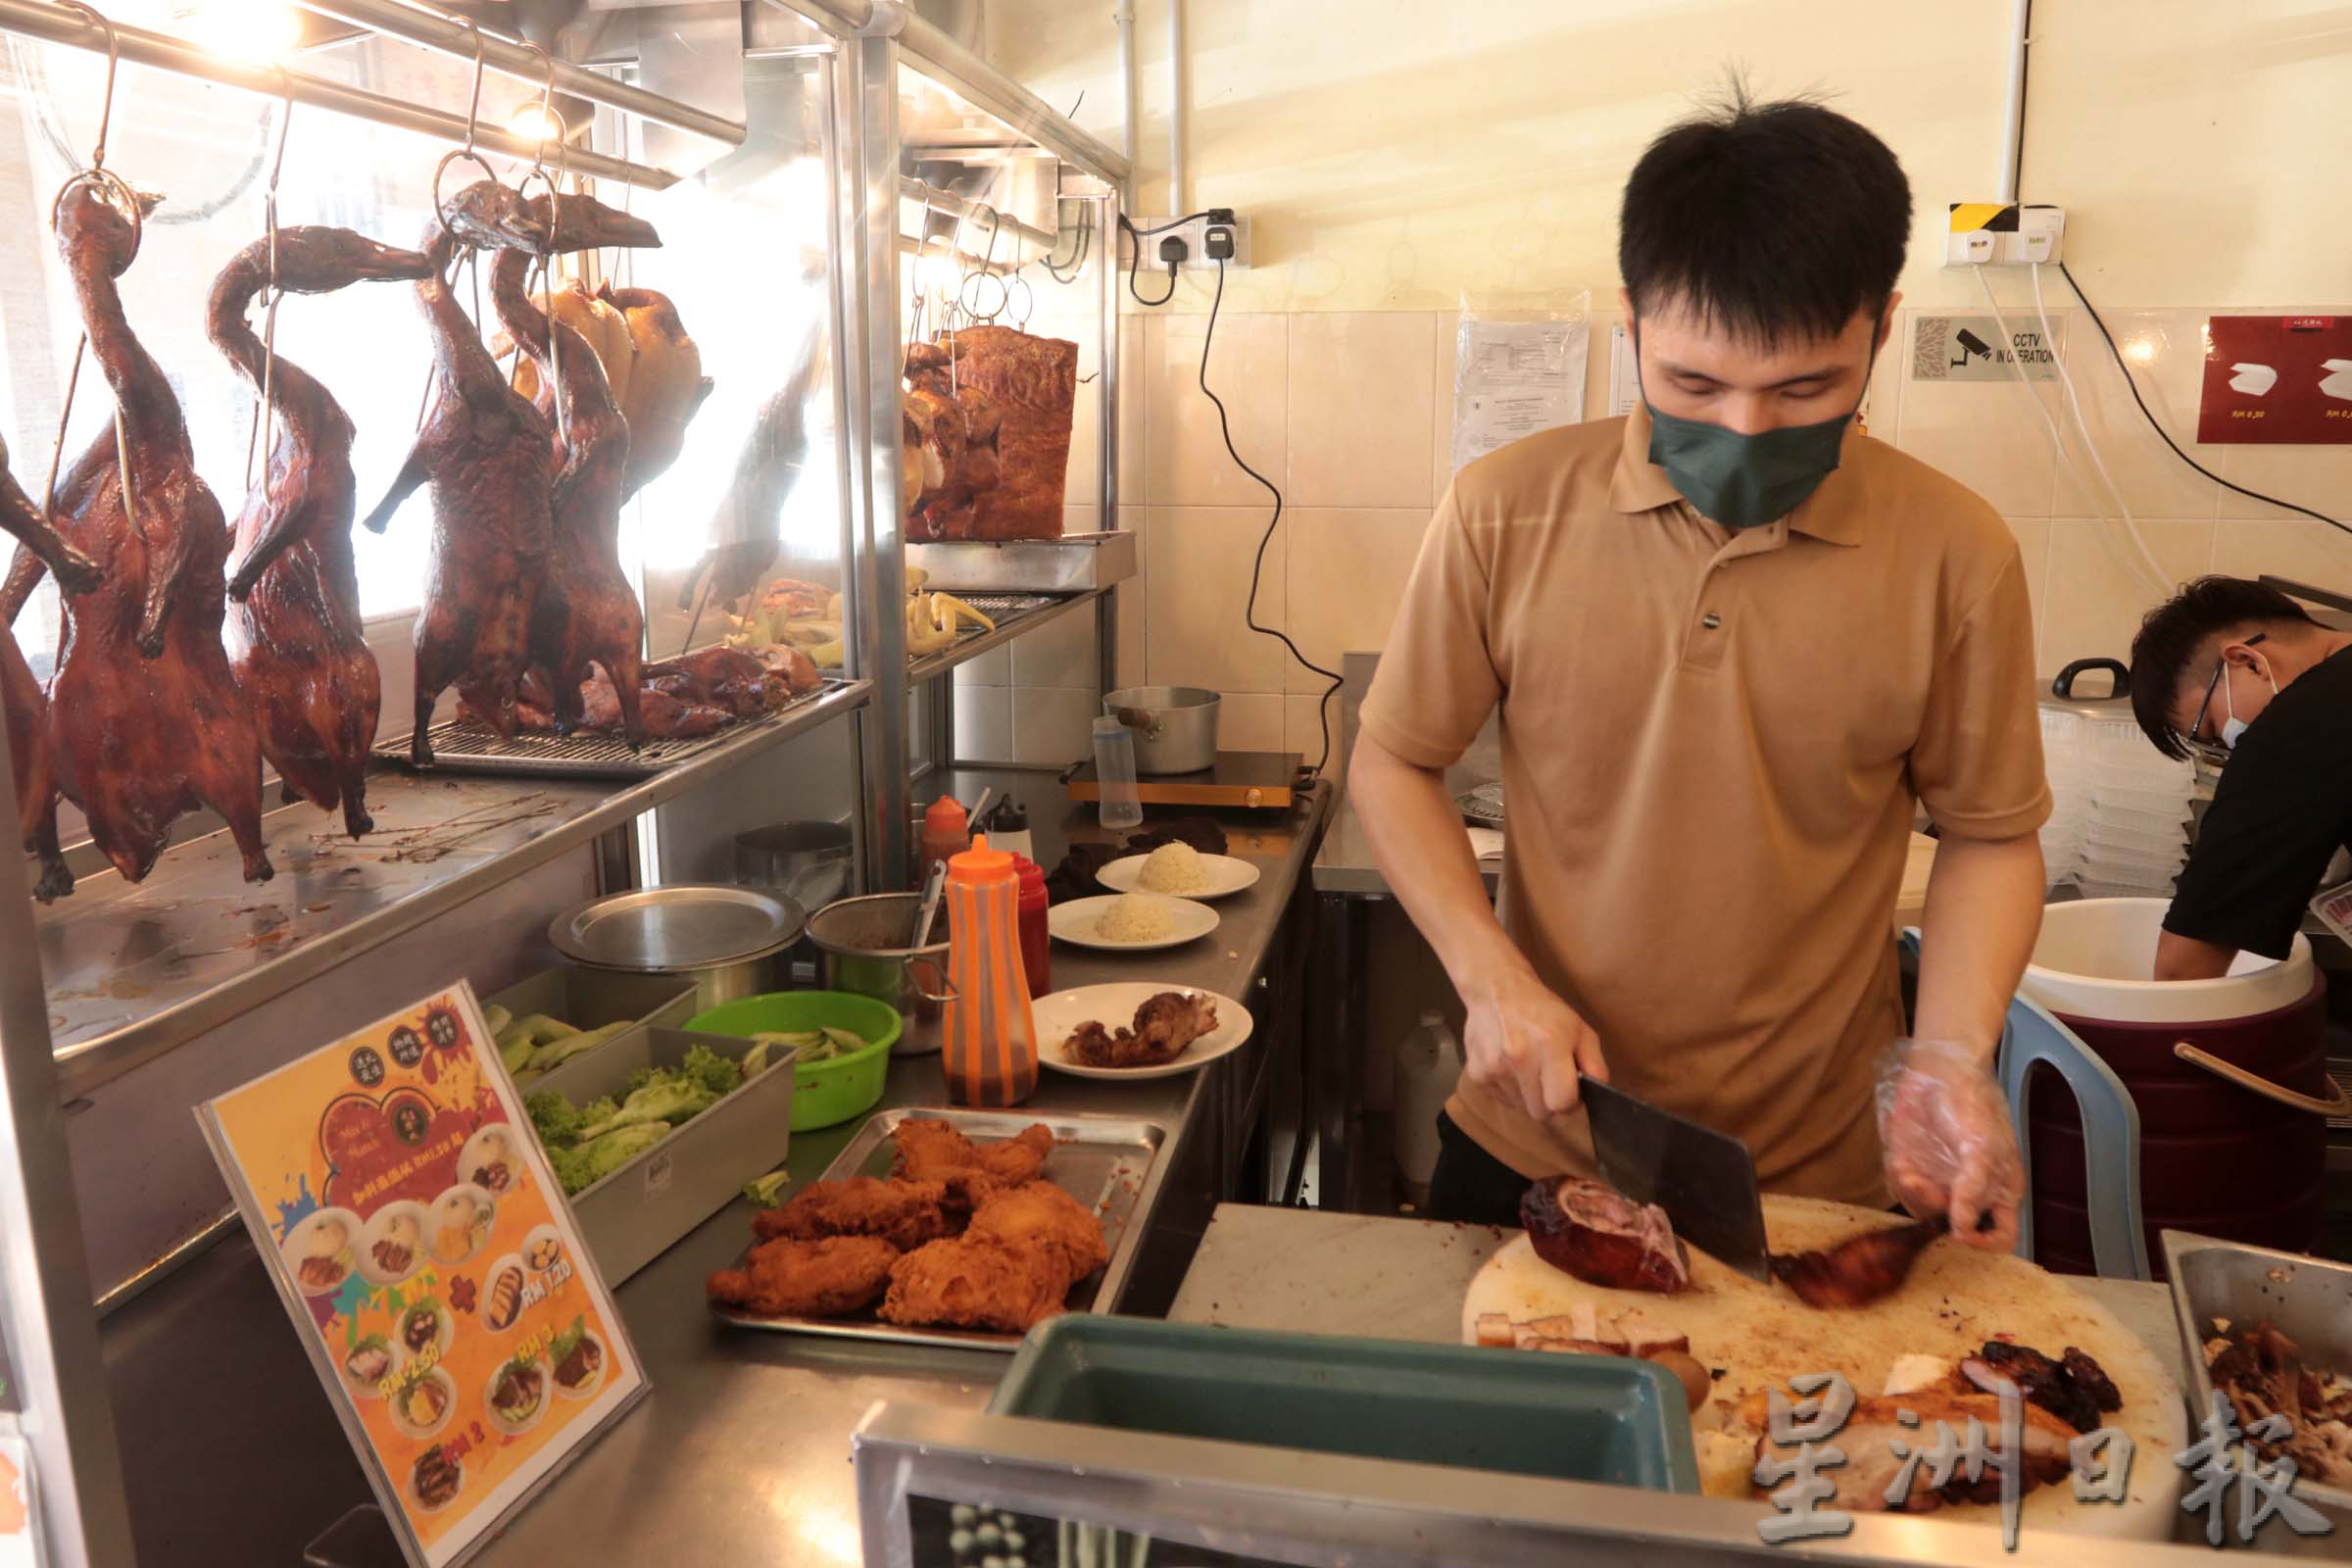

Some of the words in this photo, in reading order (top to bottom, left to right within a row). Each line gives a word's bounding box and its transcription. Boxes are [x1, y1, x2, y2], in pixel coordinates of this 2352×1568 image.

[2013, 333, 2040, 347] CCTV
[1996, 350, 2005, 363] IN
[2006, 350, 2054, 363] OERATION
[2231, 410, 2245, 418] RM
[2327, 409, 2339, 417] RM
[520, 1280, 549, 1309] RM
[517, 1334, 542, 1364] RM
[377, 1370, 408, 1399] RM
[407, 1341, 441, 1380] 2.50
[442, 1432, 472, 1466] RM
